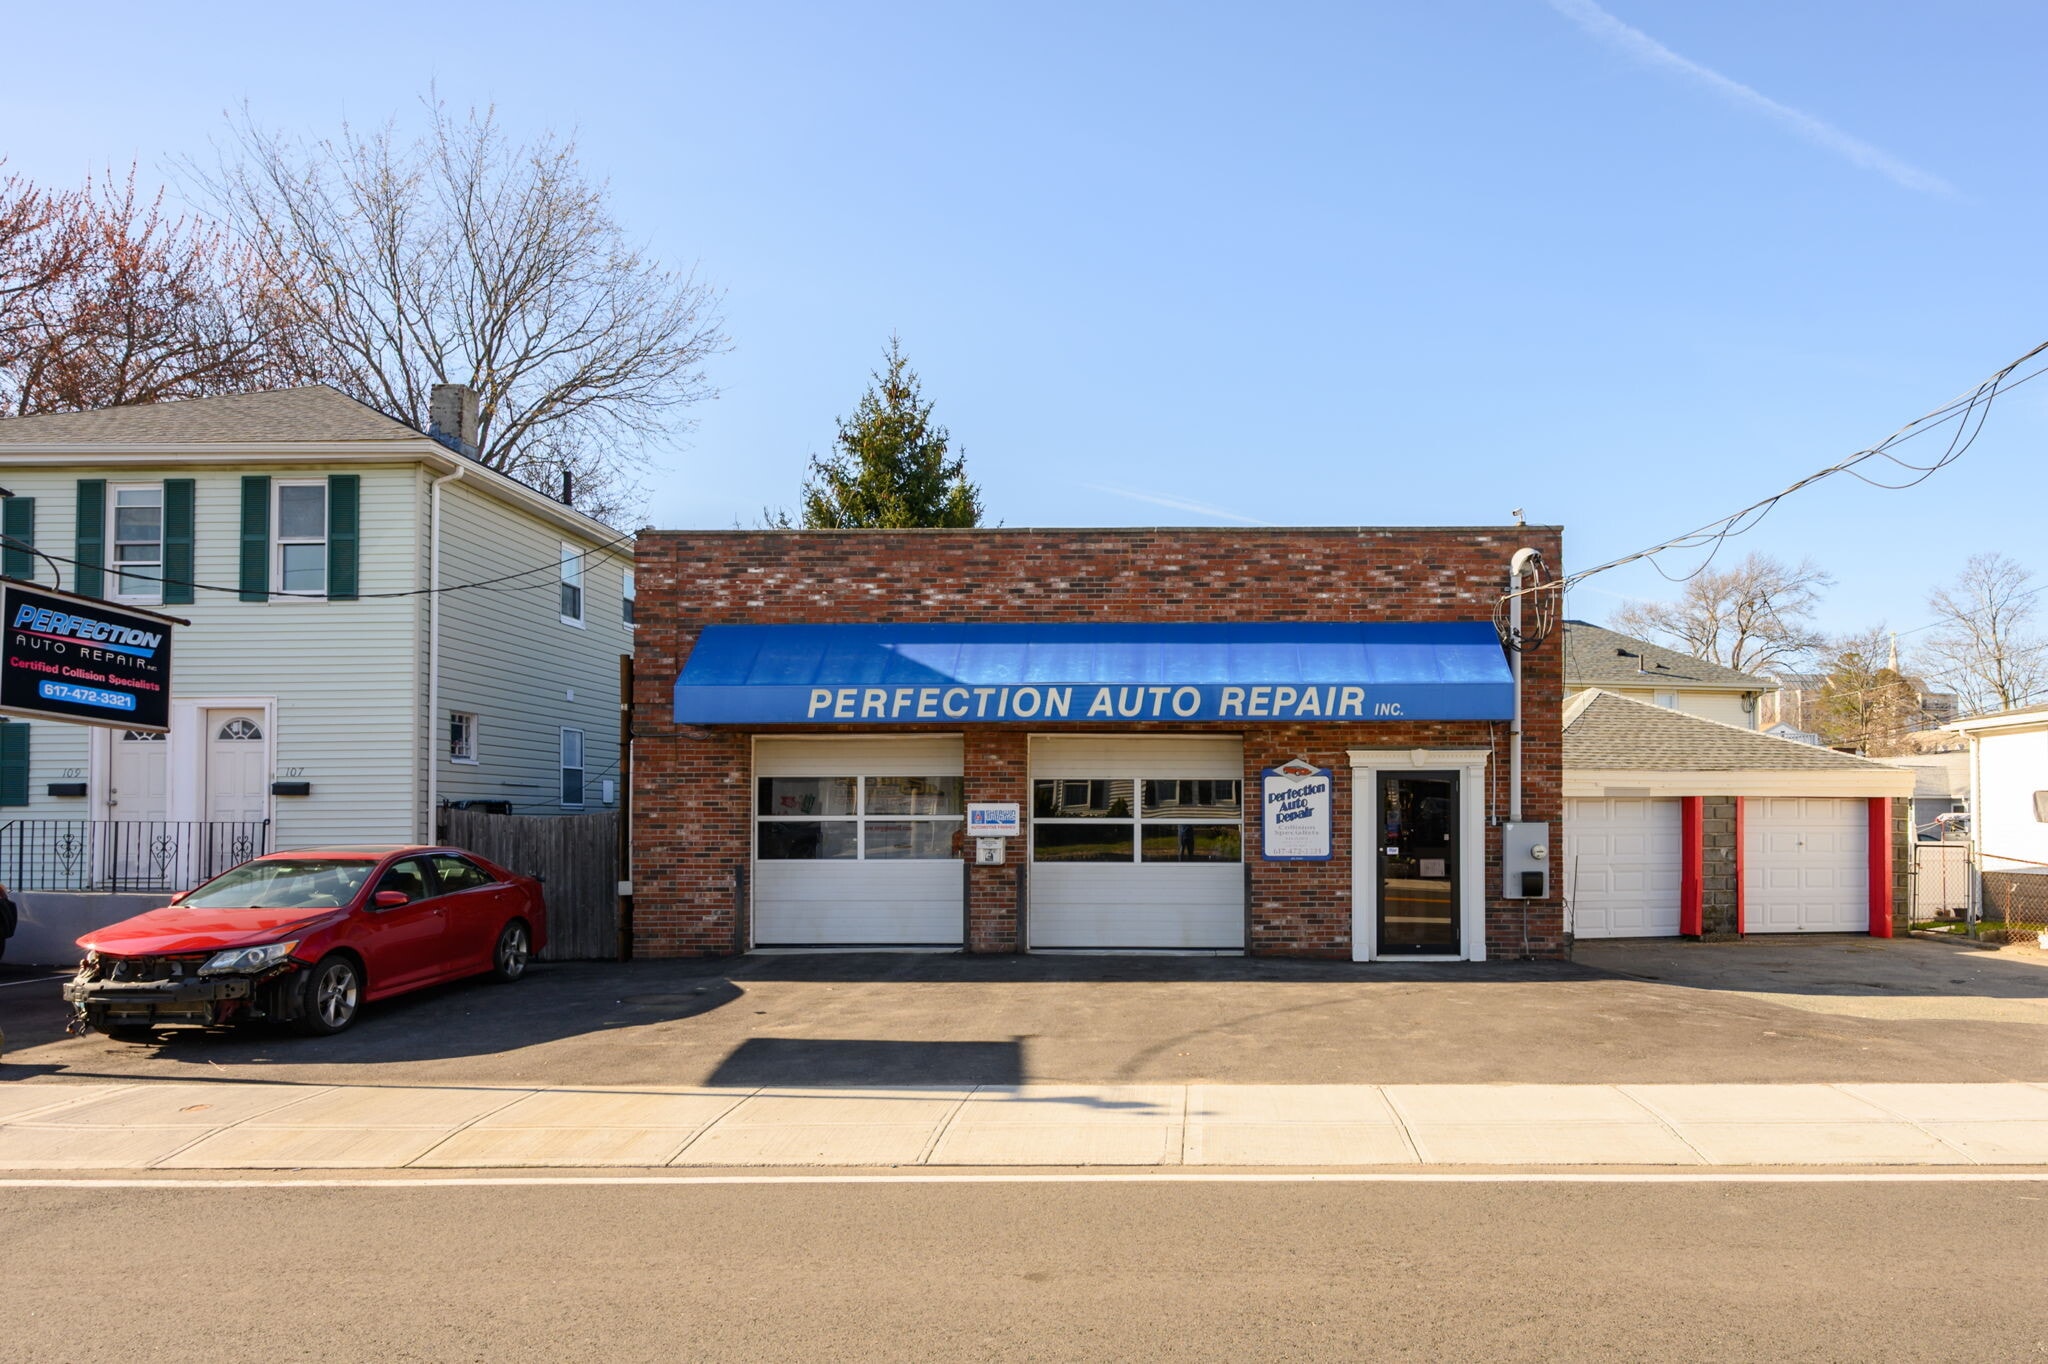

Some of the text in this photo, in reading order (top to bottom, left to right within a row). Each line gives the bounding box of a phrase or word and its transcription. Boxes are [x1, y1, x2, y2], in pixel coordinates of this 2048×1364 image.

[13, 604, 162, 648] PERFECTION
[16, 634, 66, 654] AUTO
[80, 647, 146, 669] REPAIR
[9, 656, 161, 692] Certified Collision Specialists
[44, 683, 131, 707] 617-472-3321
[807, 686, 1405, 718] PERFECTION AUTO REPAIR INC.
[62, 767, 81, 778] 109
[285, 767, 304, 777] 107
[1268, 783, 1326, 804] Perfection
[1276, 807, 1315, 824] Repair
[1279, 798, 1308, 812] Auto
